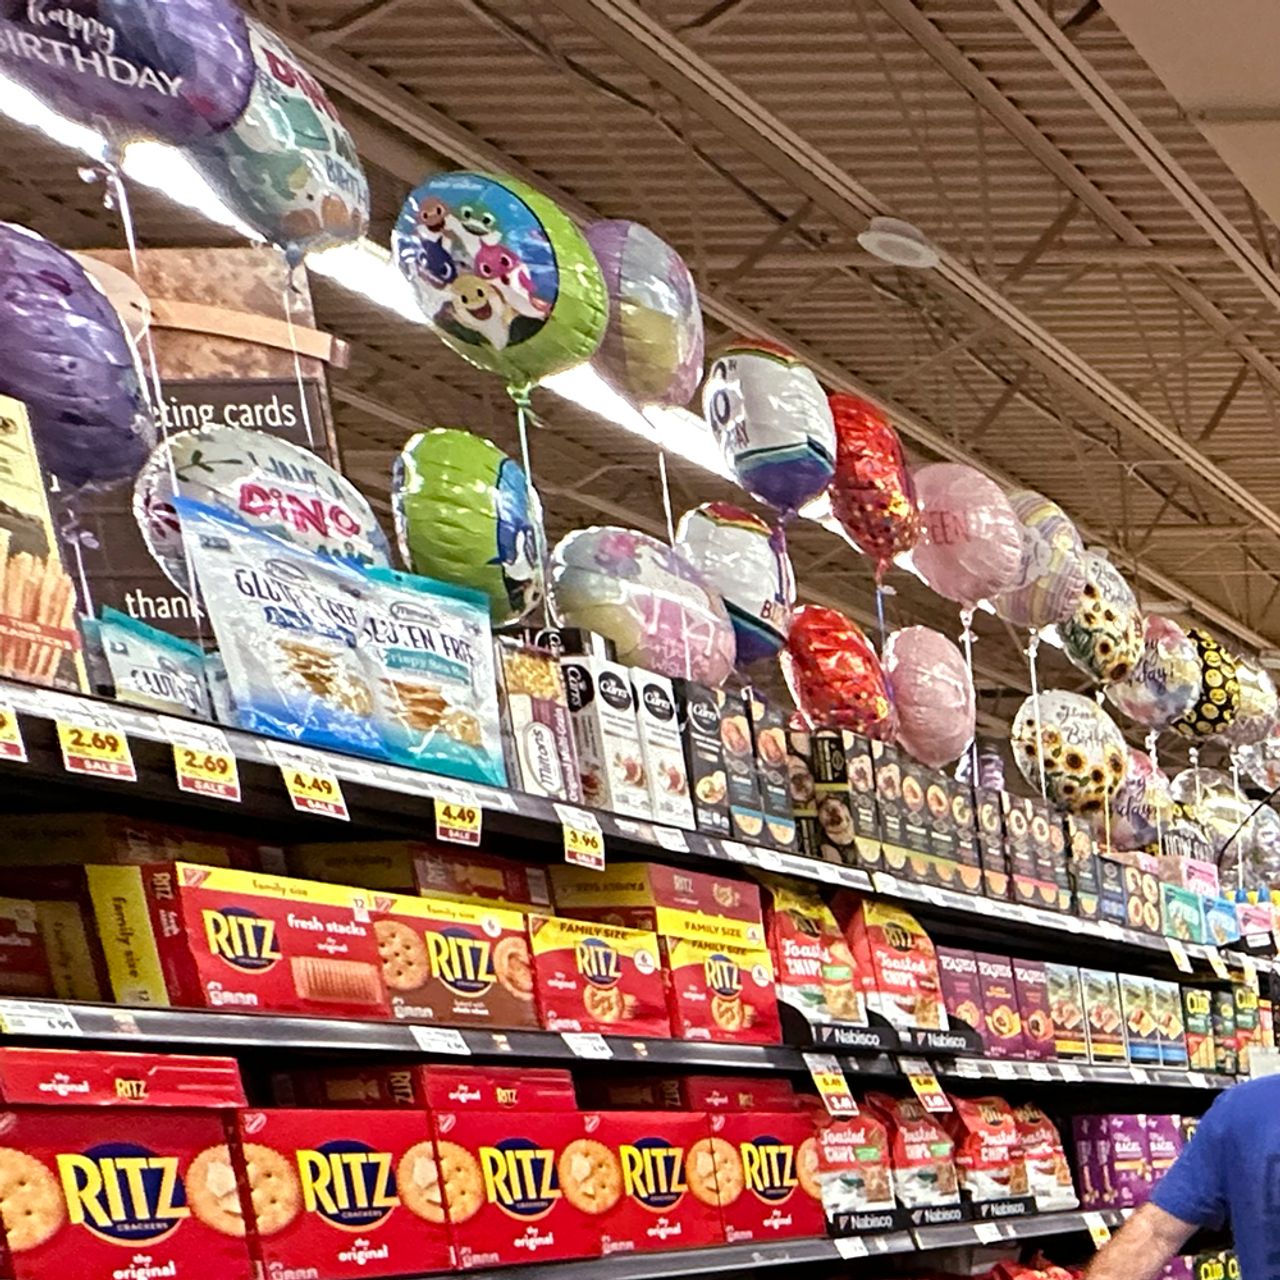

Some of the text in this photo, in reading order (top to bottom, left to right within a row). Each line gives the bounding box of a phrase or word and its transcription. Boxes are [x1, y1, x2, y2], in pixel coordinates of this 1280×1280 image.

[154, 395, 297, 428] eting cards
[69, 727, 120, 753] 2.69
[184, 749, 229, 776] 2.69
[293, 773, 333, 796] 4.49
[441, 805, 480, 826] 4.49
[202, 908, 284, 962] RITZ
[683, 920, 743, 940] FAMILY SIZE
[425, 929, 500, 984] RITZ
[575, 942, 624, 979] RITZ
[703, 958, 744, 993] RITZ
[835, 1028, 881, 1047] Nabisco
[295, 1149, 402, 1215] RITZ
[478, 1145, 563, 1205] RITZ
[619, 1144, 690, 1198] RITZ
[739, 1141, 799, 1194] RITZ
[54, 1152, 192, 1228] RITZ
[850, 1213, 893, 1230] Nabisco
[338, 1243, 390, 1267] original
[512, 1232, 555, 1252] original
